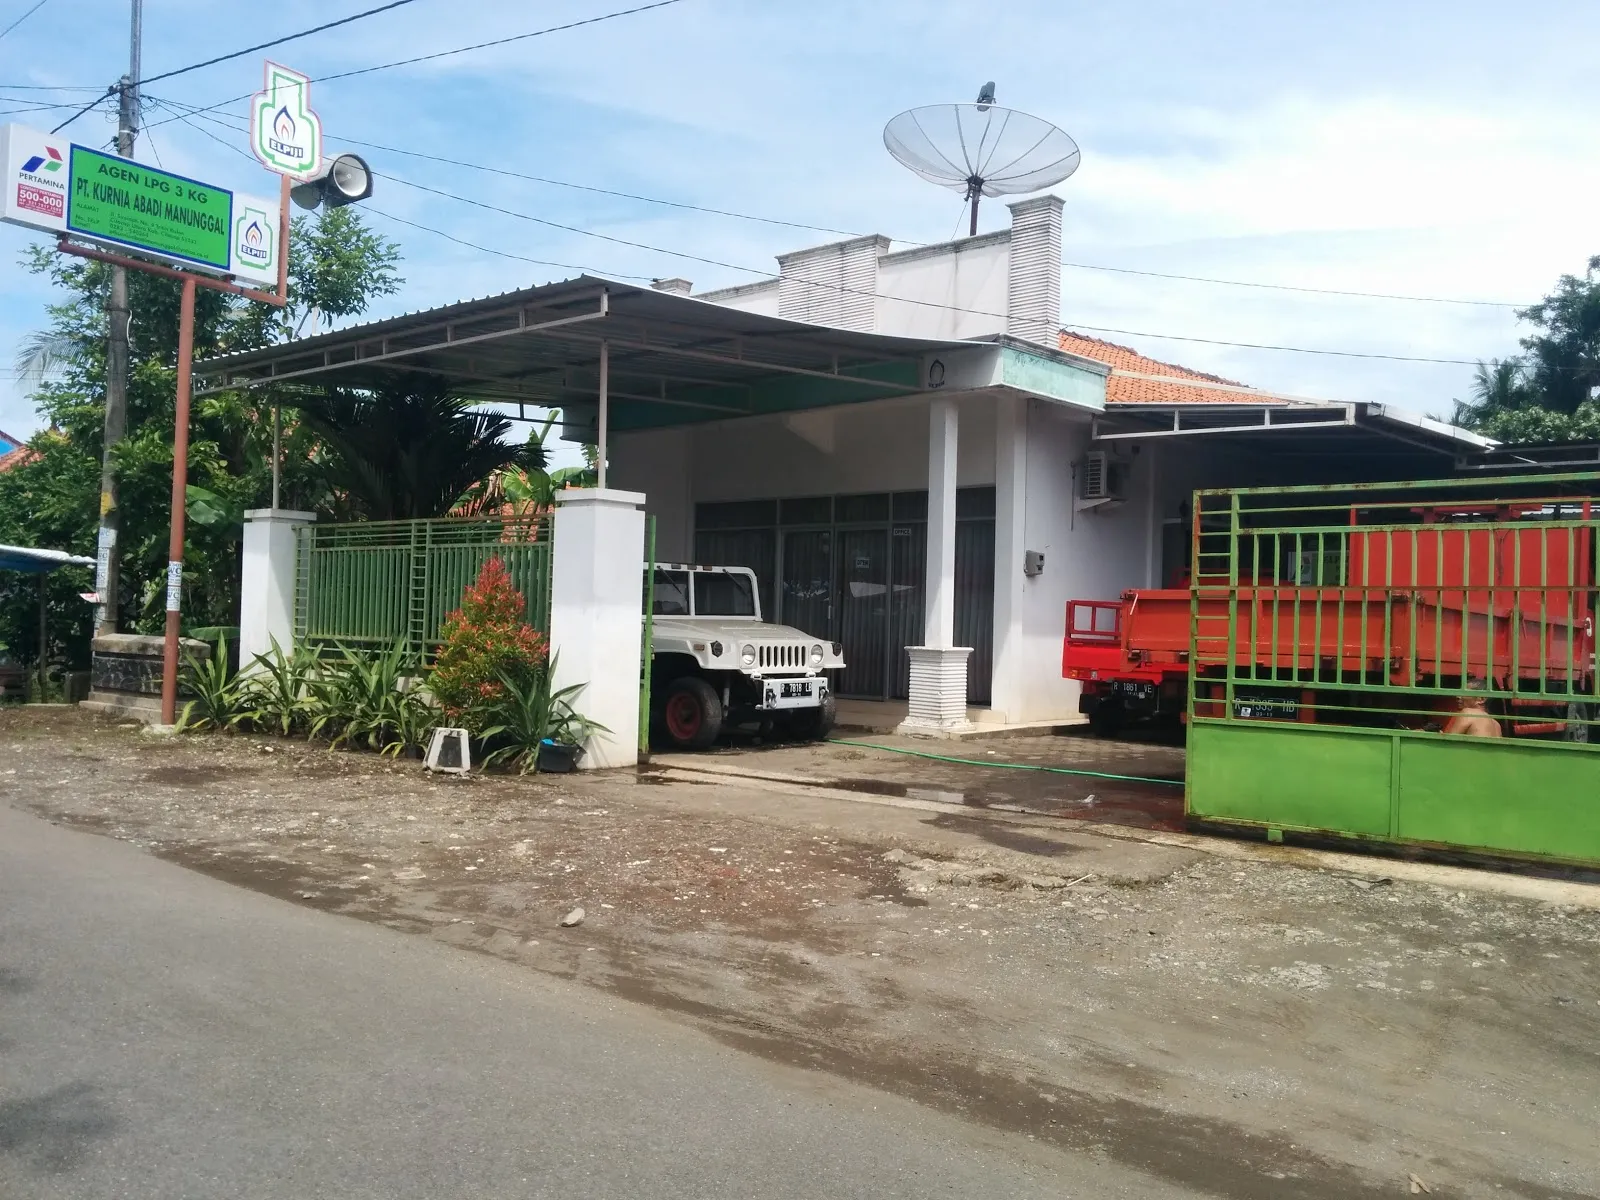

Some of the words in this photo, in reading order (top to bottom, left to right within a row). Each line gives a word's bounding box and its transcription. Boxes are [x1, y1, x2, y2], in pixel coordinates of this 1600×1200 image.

[270, 139, 303, 159] ELPIJI
[19, 172, 65, 190] PERTAMINA
[98, 163, 140, 184] AGEN
[144, 176, 171, 193] LPG
[175, 185, 183, 197] 3
[188, 189, 208, 204] KG
[19, 189, 63, 208] 500-000
[76, 177, 90, 198] PT.
[93, 181, 131, 210] KURNIA
[133, 193, 162, 218] ABADI
[165, 202, 225, 236] MANUNGGAL
[76, 202, 100, 213] ALAMAT
[1113, 681, 1119, 690] R
[1123, 682, 1138, 692] 1861
